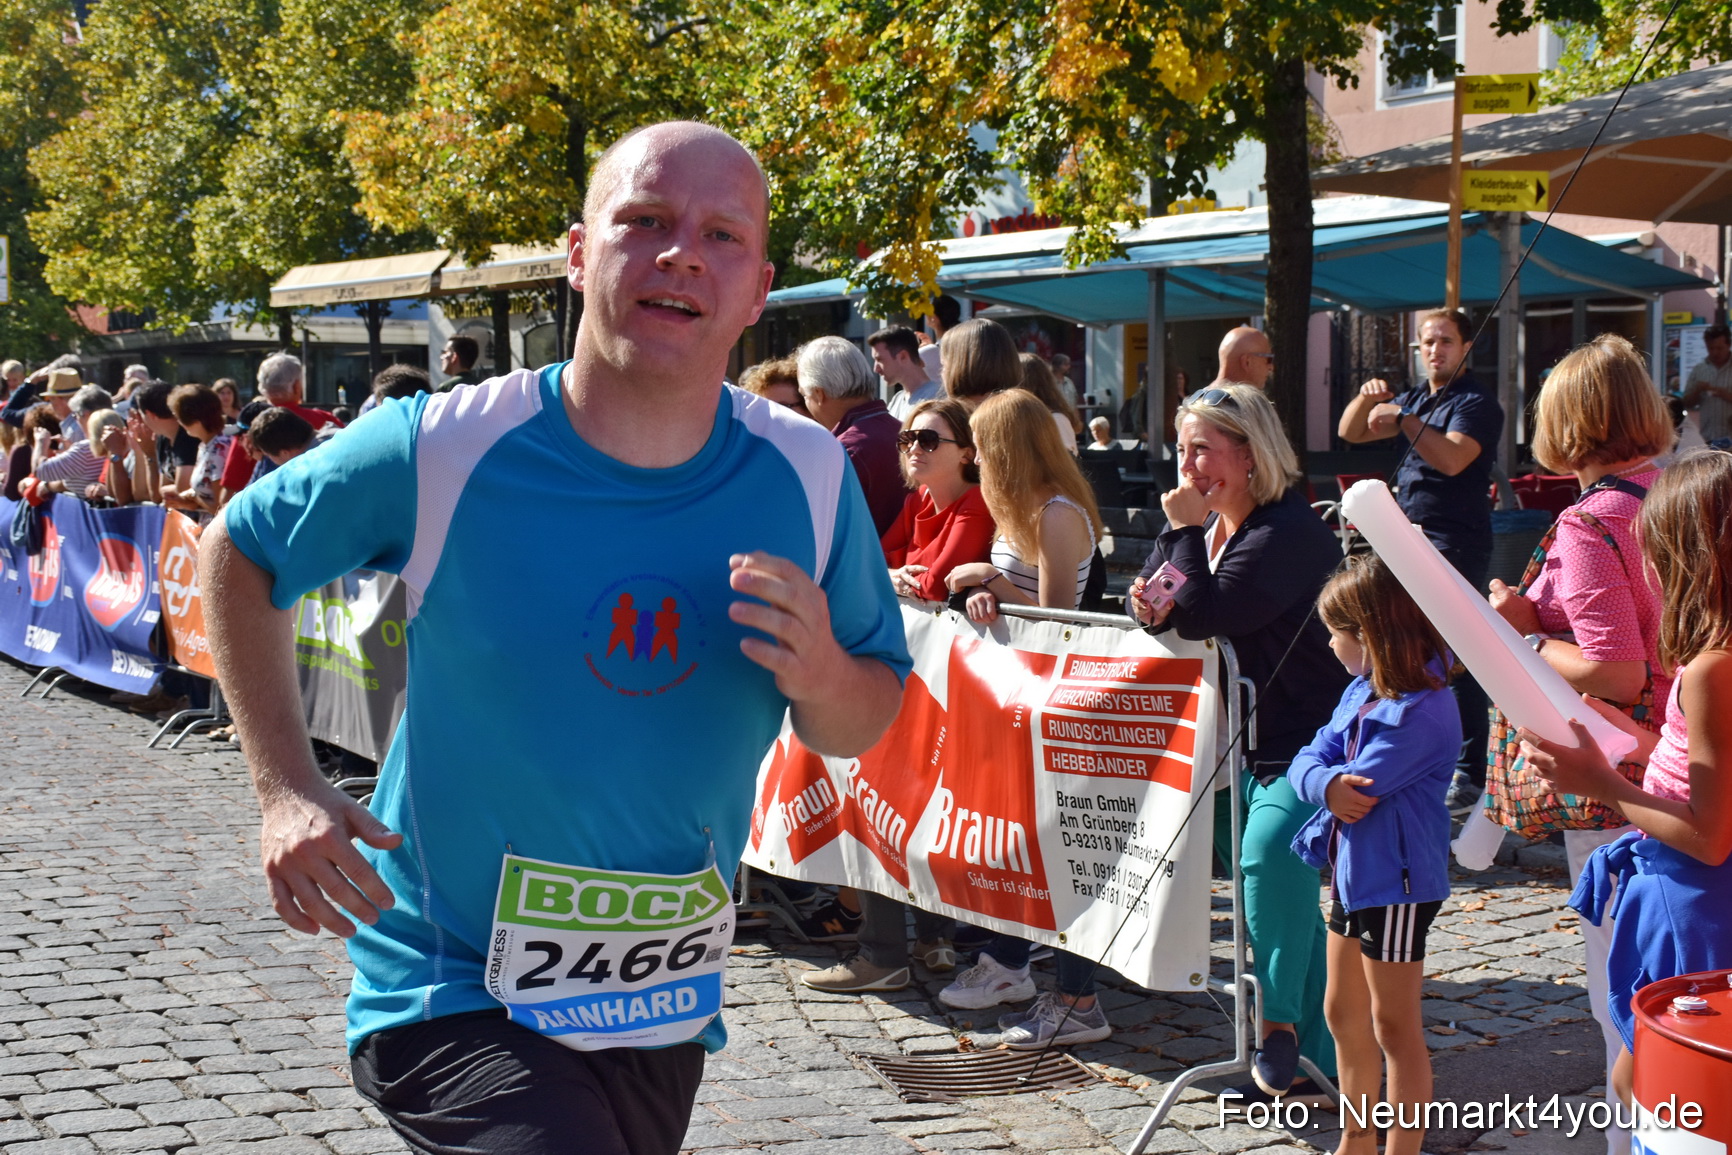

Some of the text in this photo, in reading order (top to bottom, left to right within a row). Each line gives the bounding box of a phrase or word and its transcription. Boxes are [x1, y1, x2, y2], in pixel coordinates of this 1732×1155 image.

[1054, 689, 1174, 713] VERZURRSYSTEME
[1048, 719, 1166, 746] RUNDSCHLINGEN
[1051, 752, 1148, 777] HEBEBÄNDER
[778, 777, 835, 838] Braun
[844, 757, 907, 854] Braun
[1056, 791, 1137, 814] Braun GmbH
[928, 787, 1033, 875] Braun
[1060, 812, 1145, 840] Am Grünberg 8
[1062, 831, 1112, 851] D-92318
[1067, 859, 1091, 877] Tel.
[1093, 862, 1120, 884] 09181
[967, 871, 1050, 901] Sicher ist sicher
[1072, 879, 1093, 898] Fax
[1096, 882, 1120, 906] 09181
[516, 926, 714, 992] 2466
[529, 987, 698, 1030] RAINHARD
